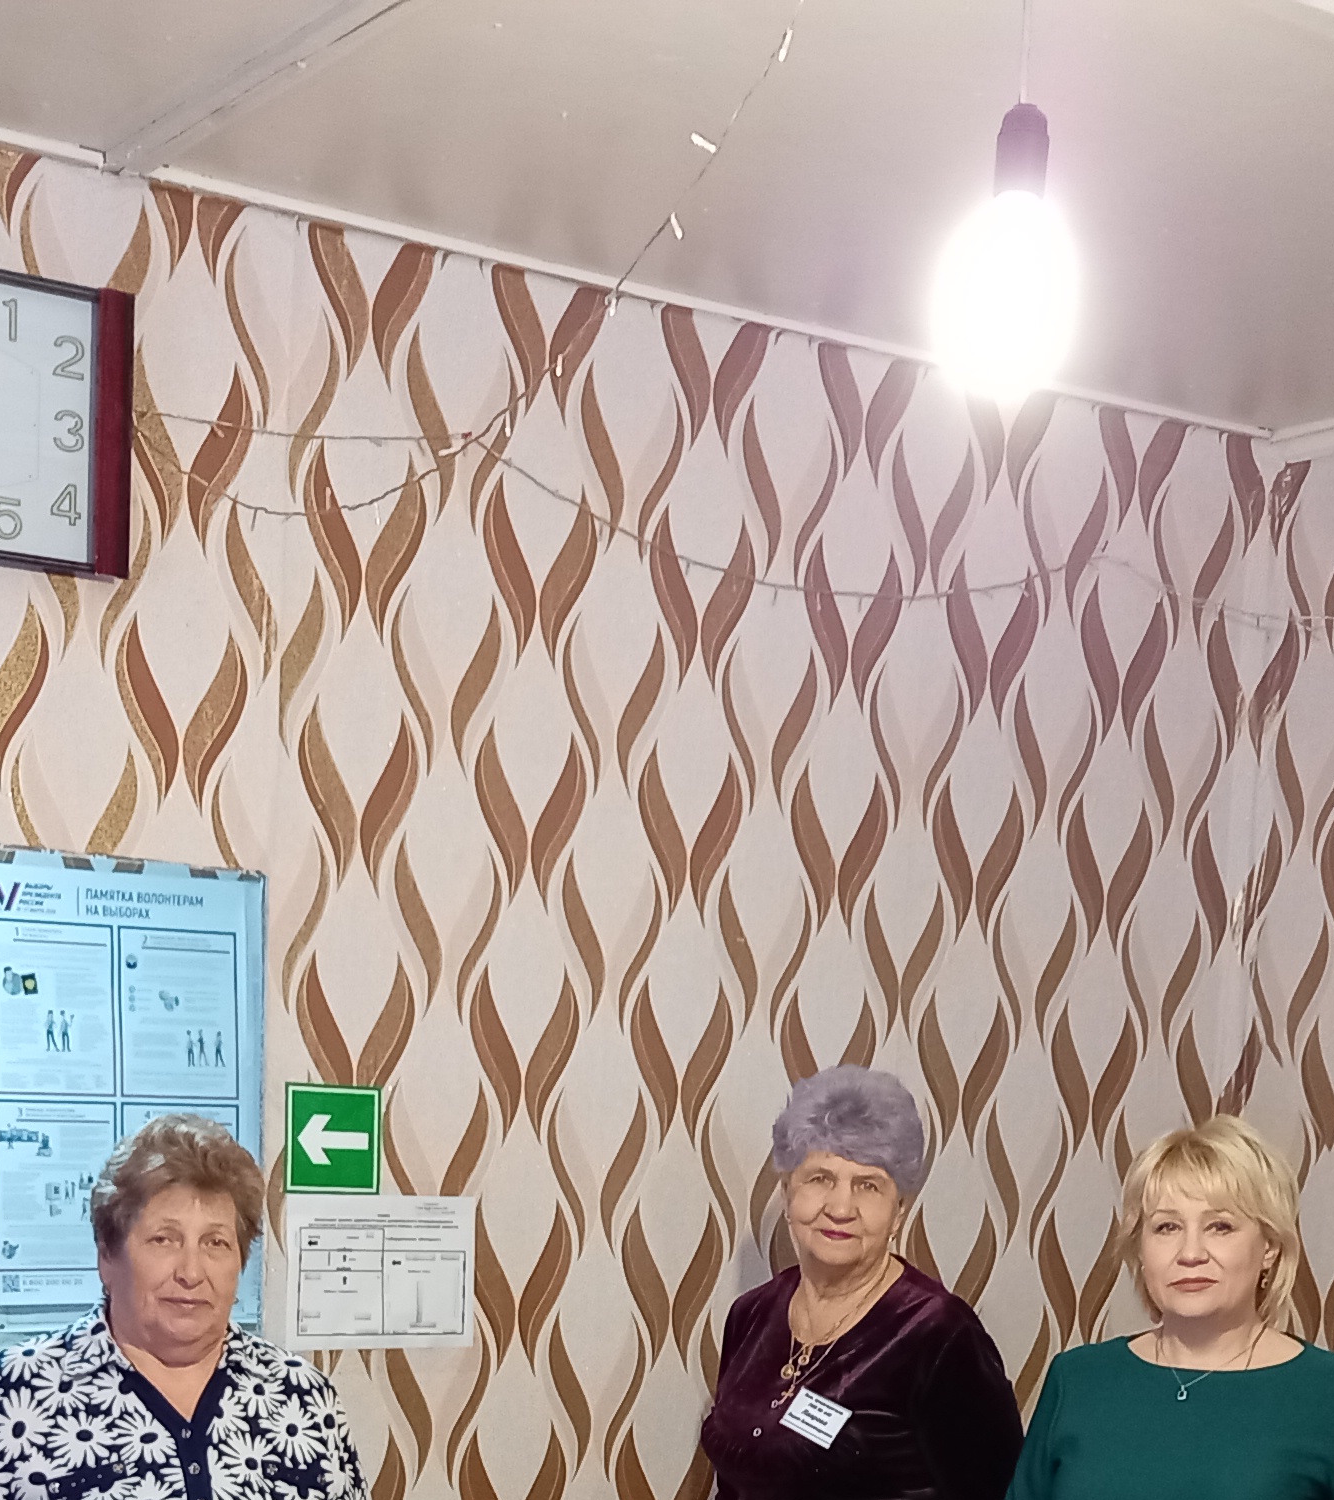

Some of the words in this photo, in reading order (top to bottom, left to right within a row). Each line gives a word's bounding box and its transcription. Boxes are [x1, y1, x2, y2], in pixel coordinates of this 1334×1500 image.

[2, 297, 18, 342] 1
[52, 335, 85, 381] 2
[52, 410, 85, 453] 3
[50, 484, 81, 526] 4
[85, 888, 134, 902] ПАМЯТКА
[136, 891, 204, 907] ВОЛОНТЕРАМ
[85, 905, 100, 917] НА
[102, 905, 151, 919] ВЫБОРАХ
